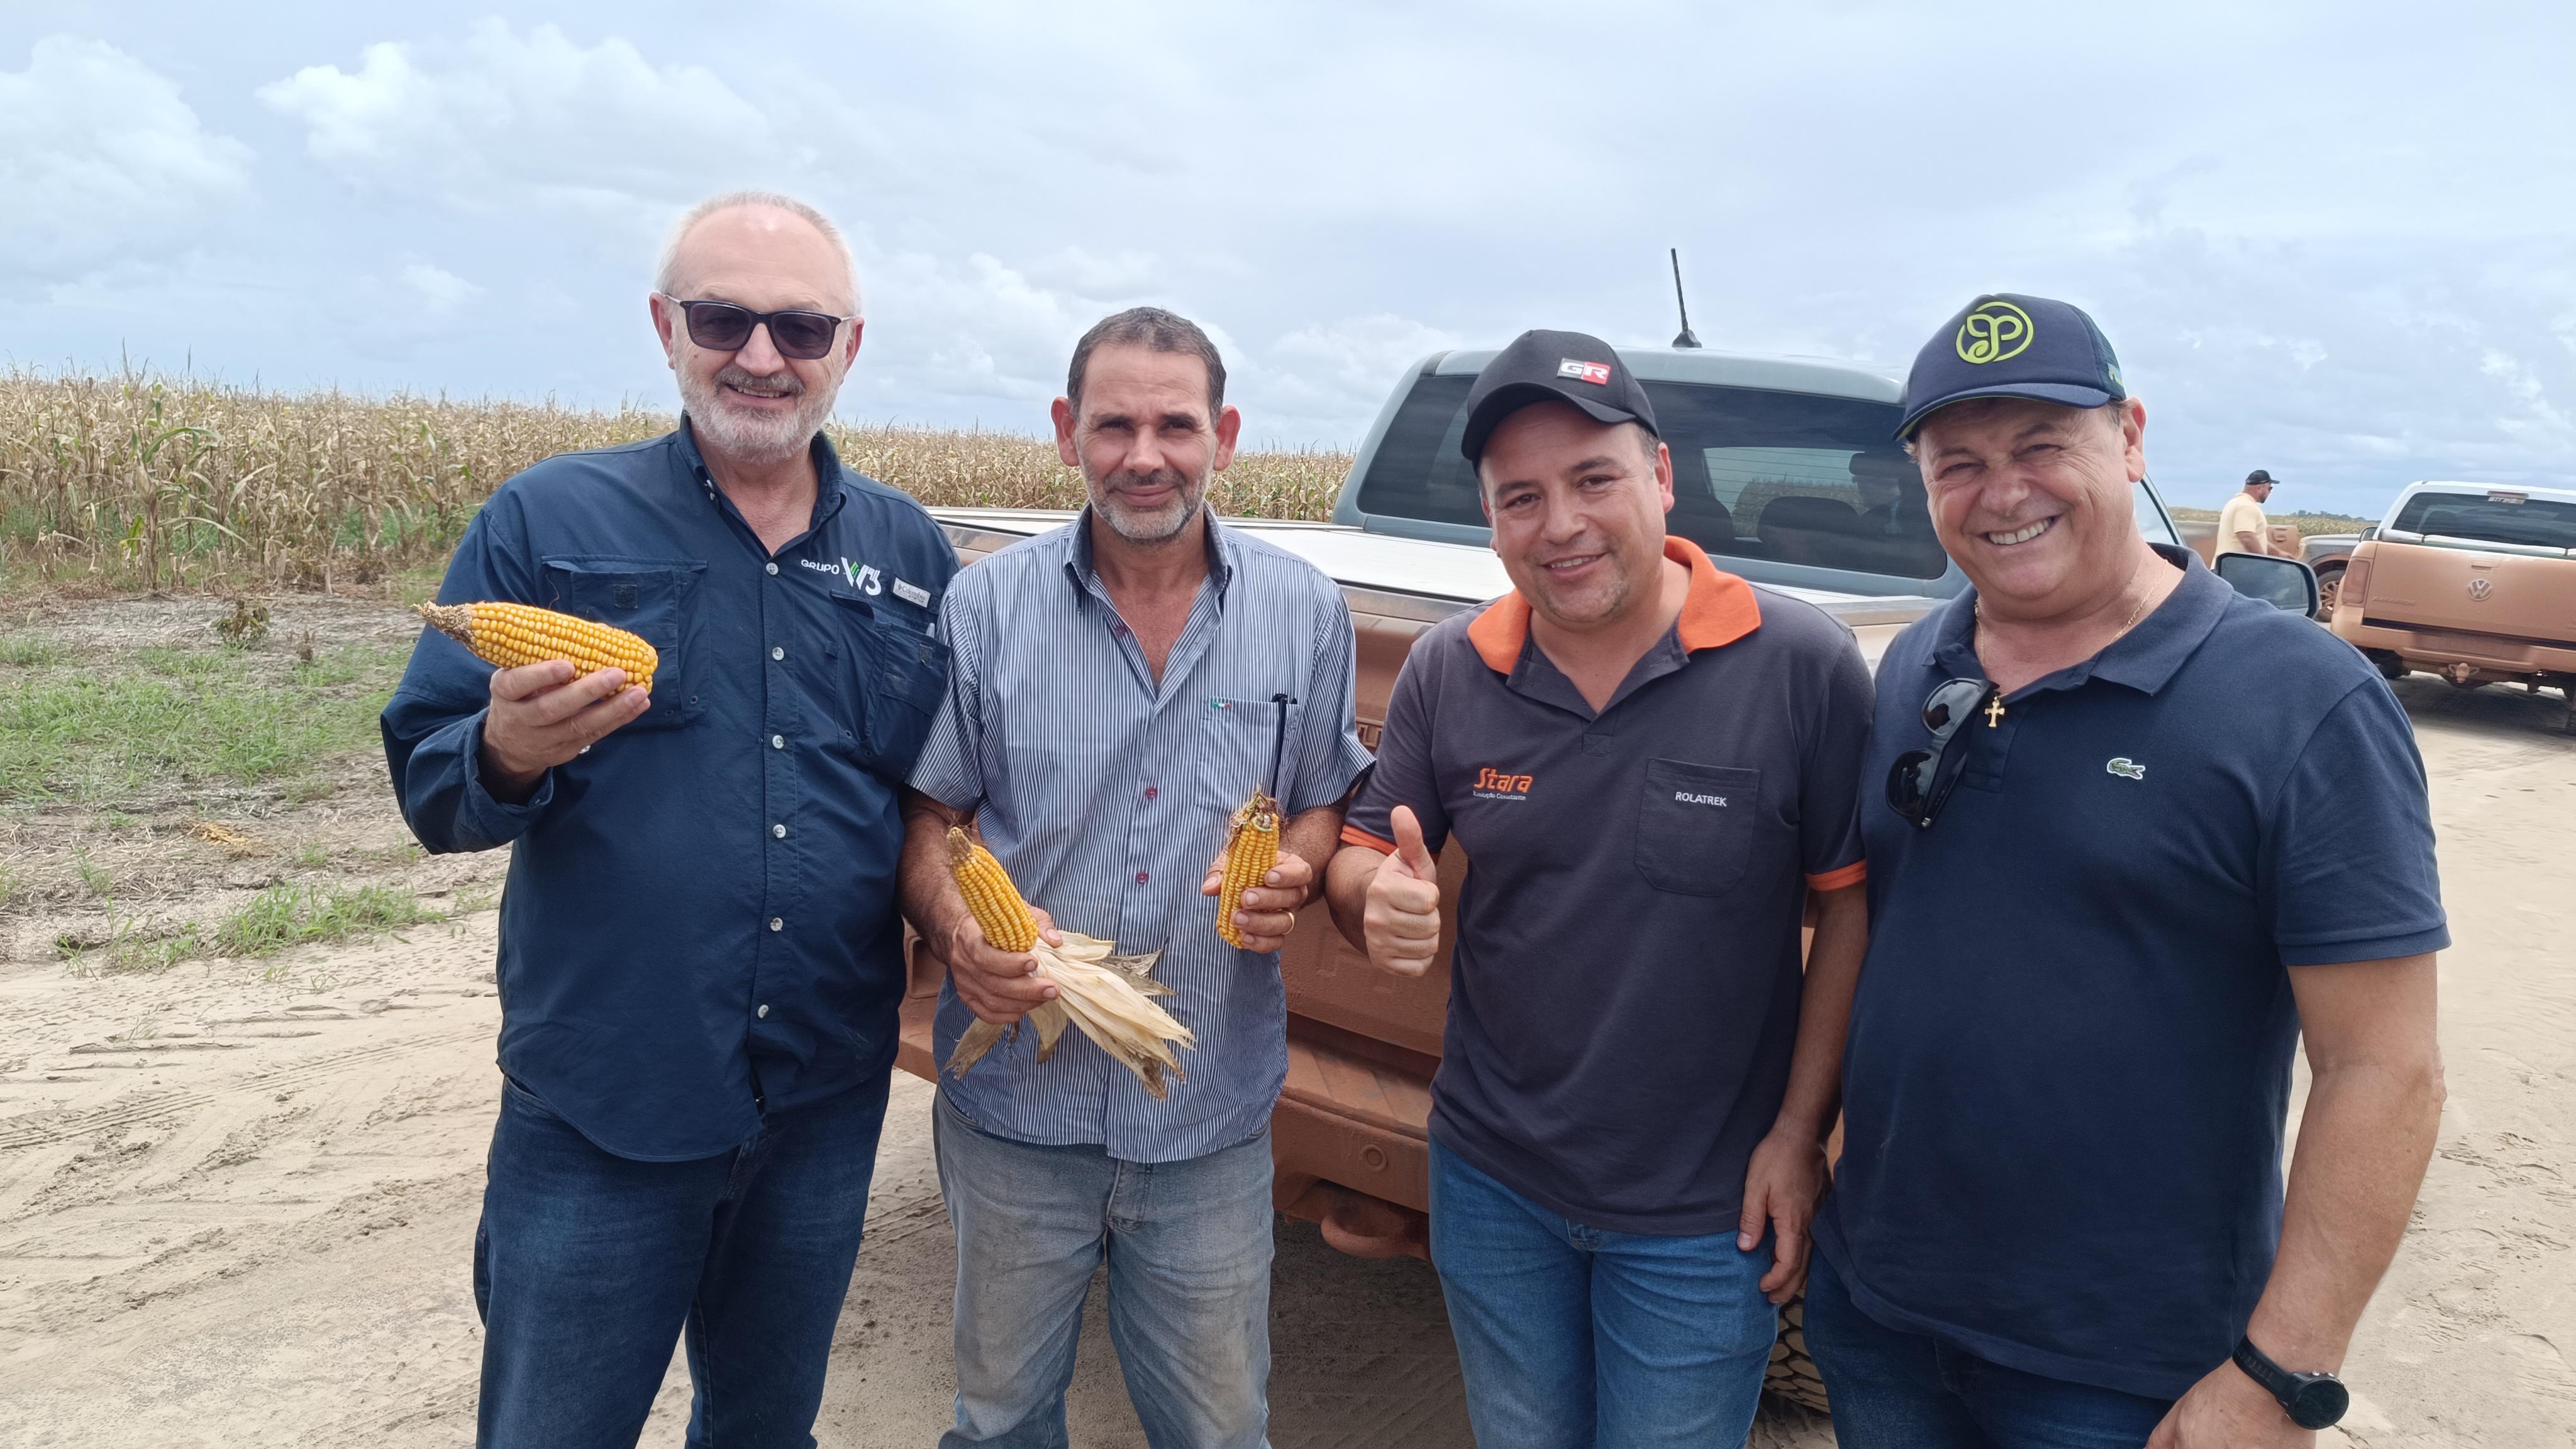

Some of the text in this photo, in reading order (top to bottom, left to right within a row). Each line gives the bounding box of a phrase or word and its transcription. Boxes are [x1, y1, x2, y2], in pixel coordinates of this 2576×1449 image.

[1560, 362, 1607, 380] GR
[801, 559, 840, 575] GRUPO
[1474, 768, 1533, 793] Stara
[1675, 791, 1727, 807] ROLATREK
